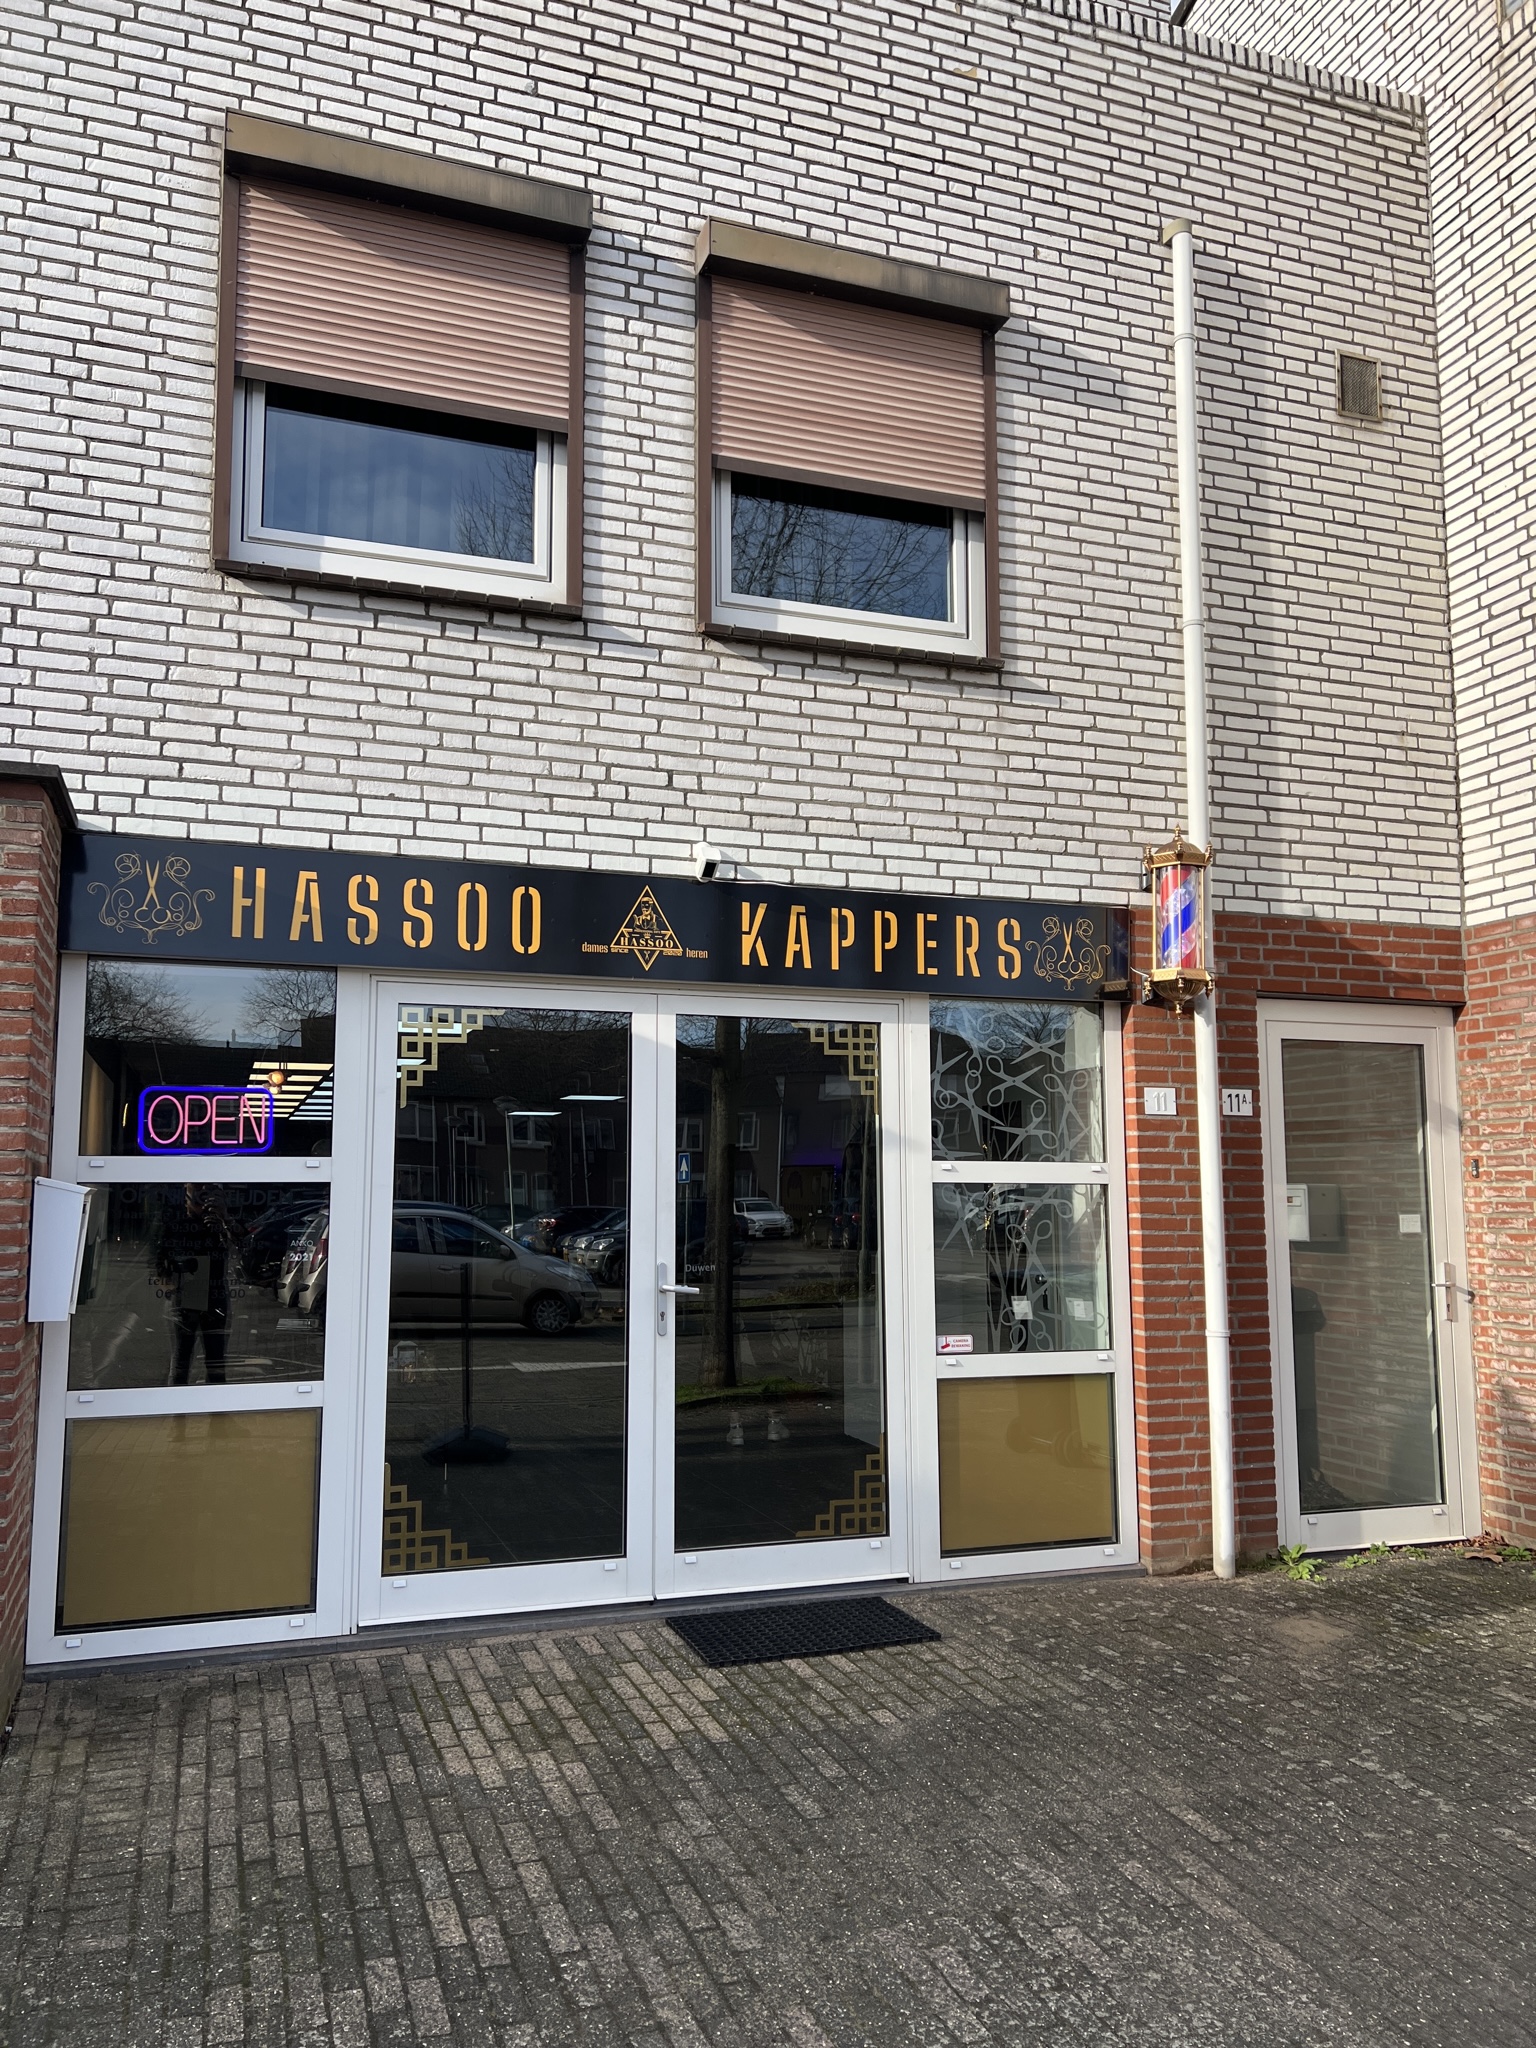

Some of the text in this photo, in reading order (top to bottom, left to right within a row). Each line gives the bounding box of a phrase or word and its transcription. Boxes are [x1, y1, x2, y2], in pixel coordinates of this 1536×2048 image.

[231, 865, 1023, 980] HASSOO KAPPERS
[581, 942, 609, 954] dames
[620, 936, 674, 949] HASSOO
[685, 948, 708, 959] heren
[1152, 1092, 1168, 1112] 11
[1227, 1093, 1248, 1113] 11A
[147, 1094, 266, 1145] OPEN
[290, 1239, 314, 1247] ANKO
[289, 1252, 314, 1262] 2021
[685, 1264, 716, 1274] Duwen
